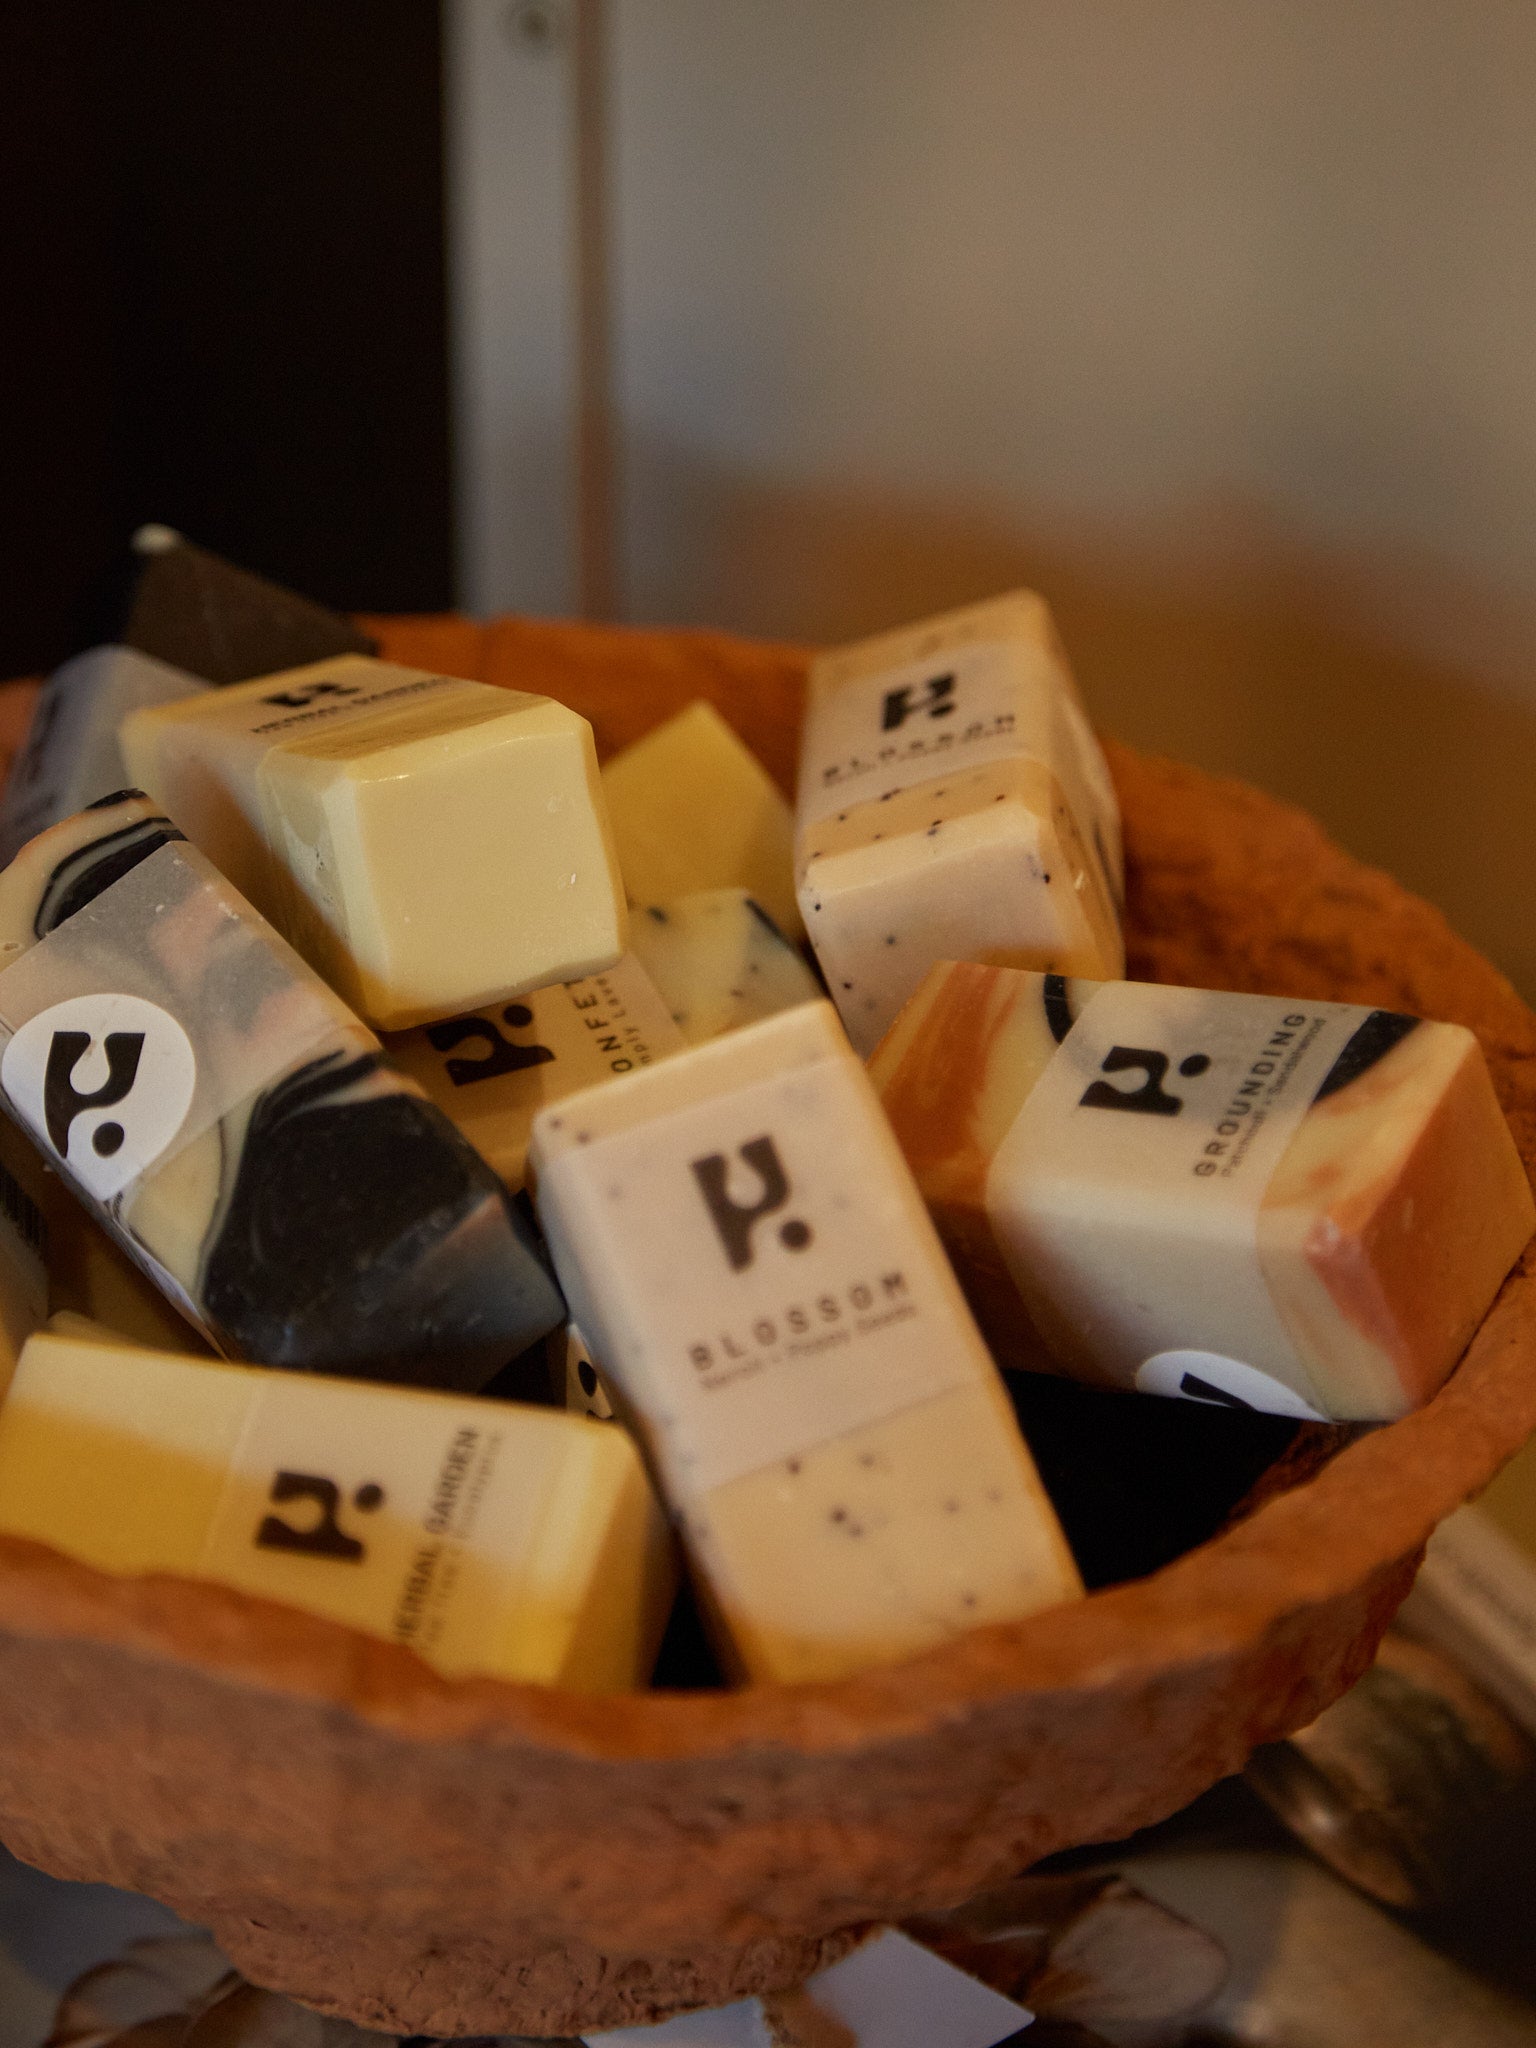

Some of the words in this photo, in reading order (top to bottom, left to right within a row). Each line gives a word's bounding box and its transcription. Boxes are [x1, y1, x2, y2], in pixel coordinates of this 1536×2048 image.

[1192, 1013, 1307, 1178] GROUNDING
[688, 1270, 908, 1372] BLOSSOM
[423, 1426, 480, 1536] GARDEN
